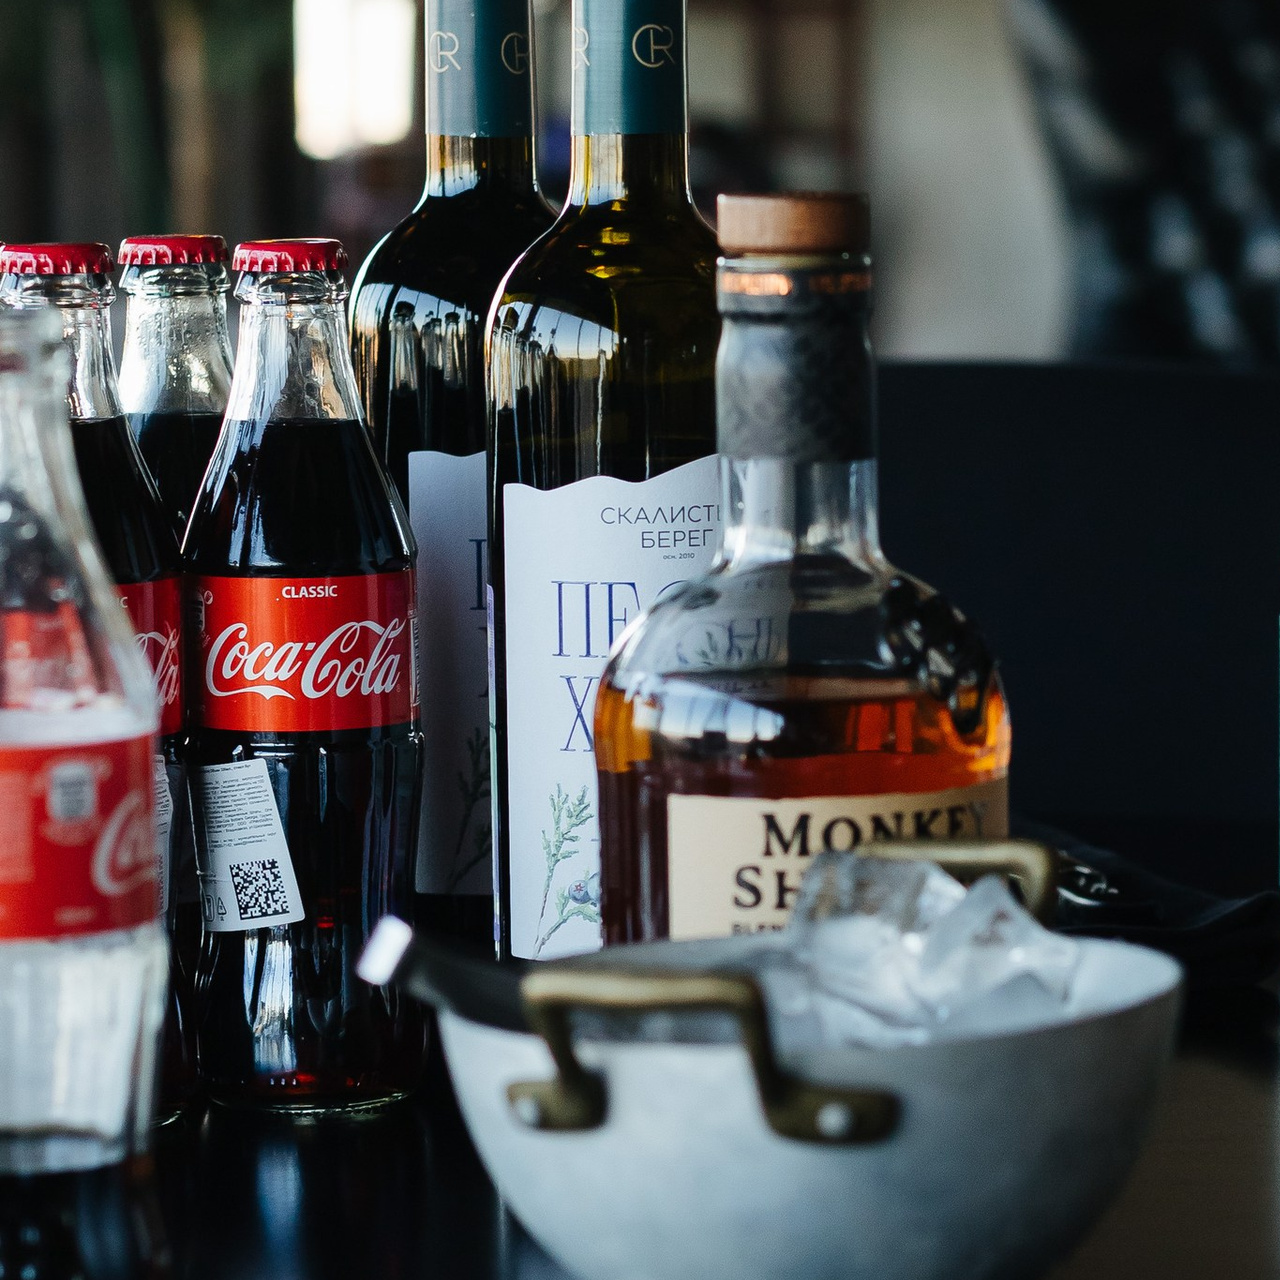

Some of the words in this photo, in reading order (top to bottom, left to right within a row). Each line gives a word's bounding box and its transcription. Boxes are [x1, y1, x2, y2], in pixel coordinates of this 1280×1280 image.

[600, 504, 720, 525] СКАЛИСТ
[641, 529, 713, 549] БЕРЕГ
[281, 585, 338, 599] CLASSIC
[206, 618, 406, 701] Coca-Cola
